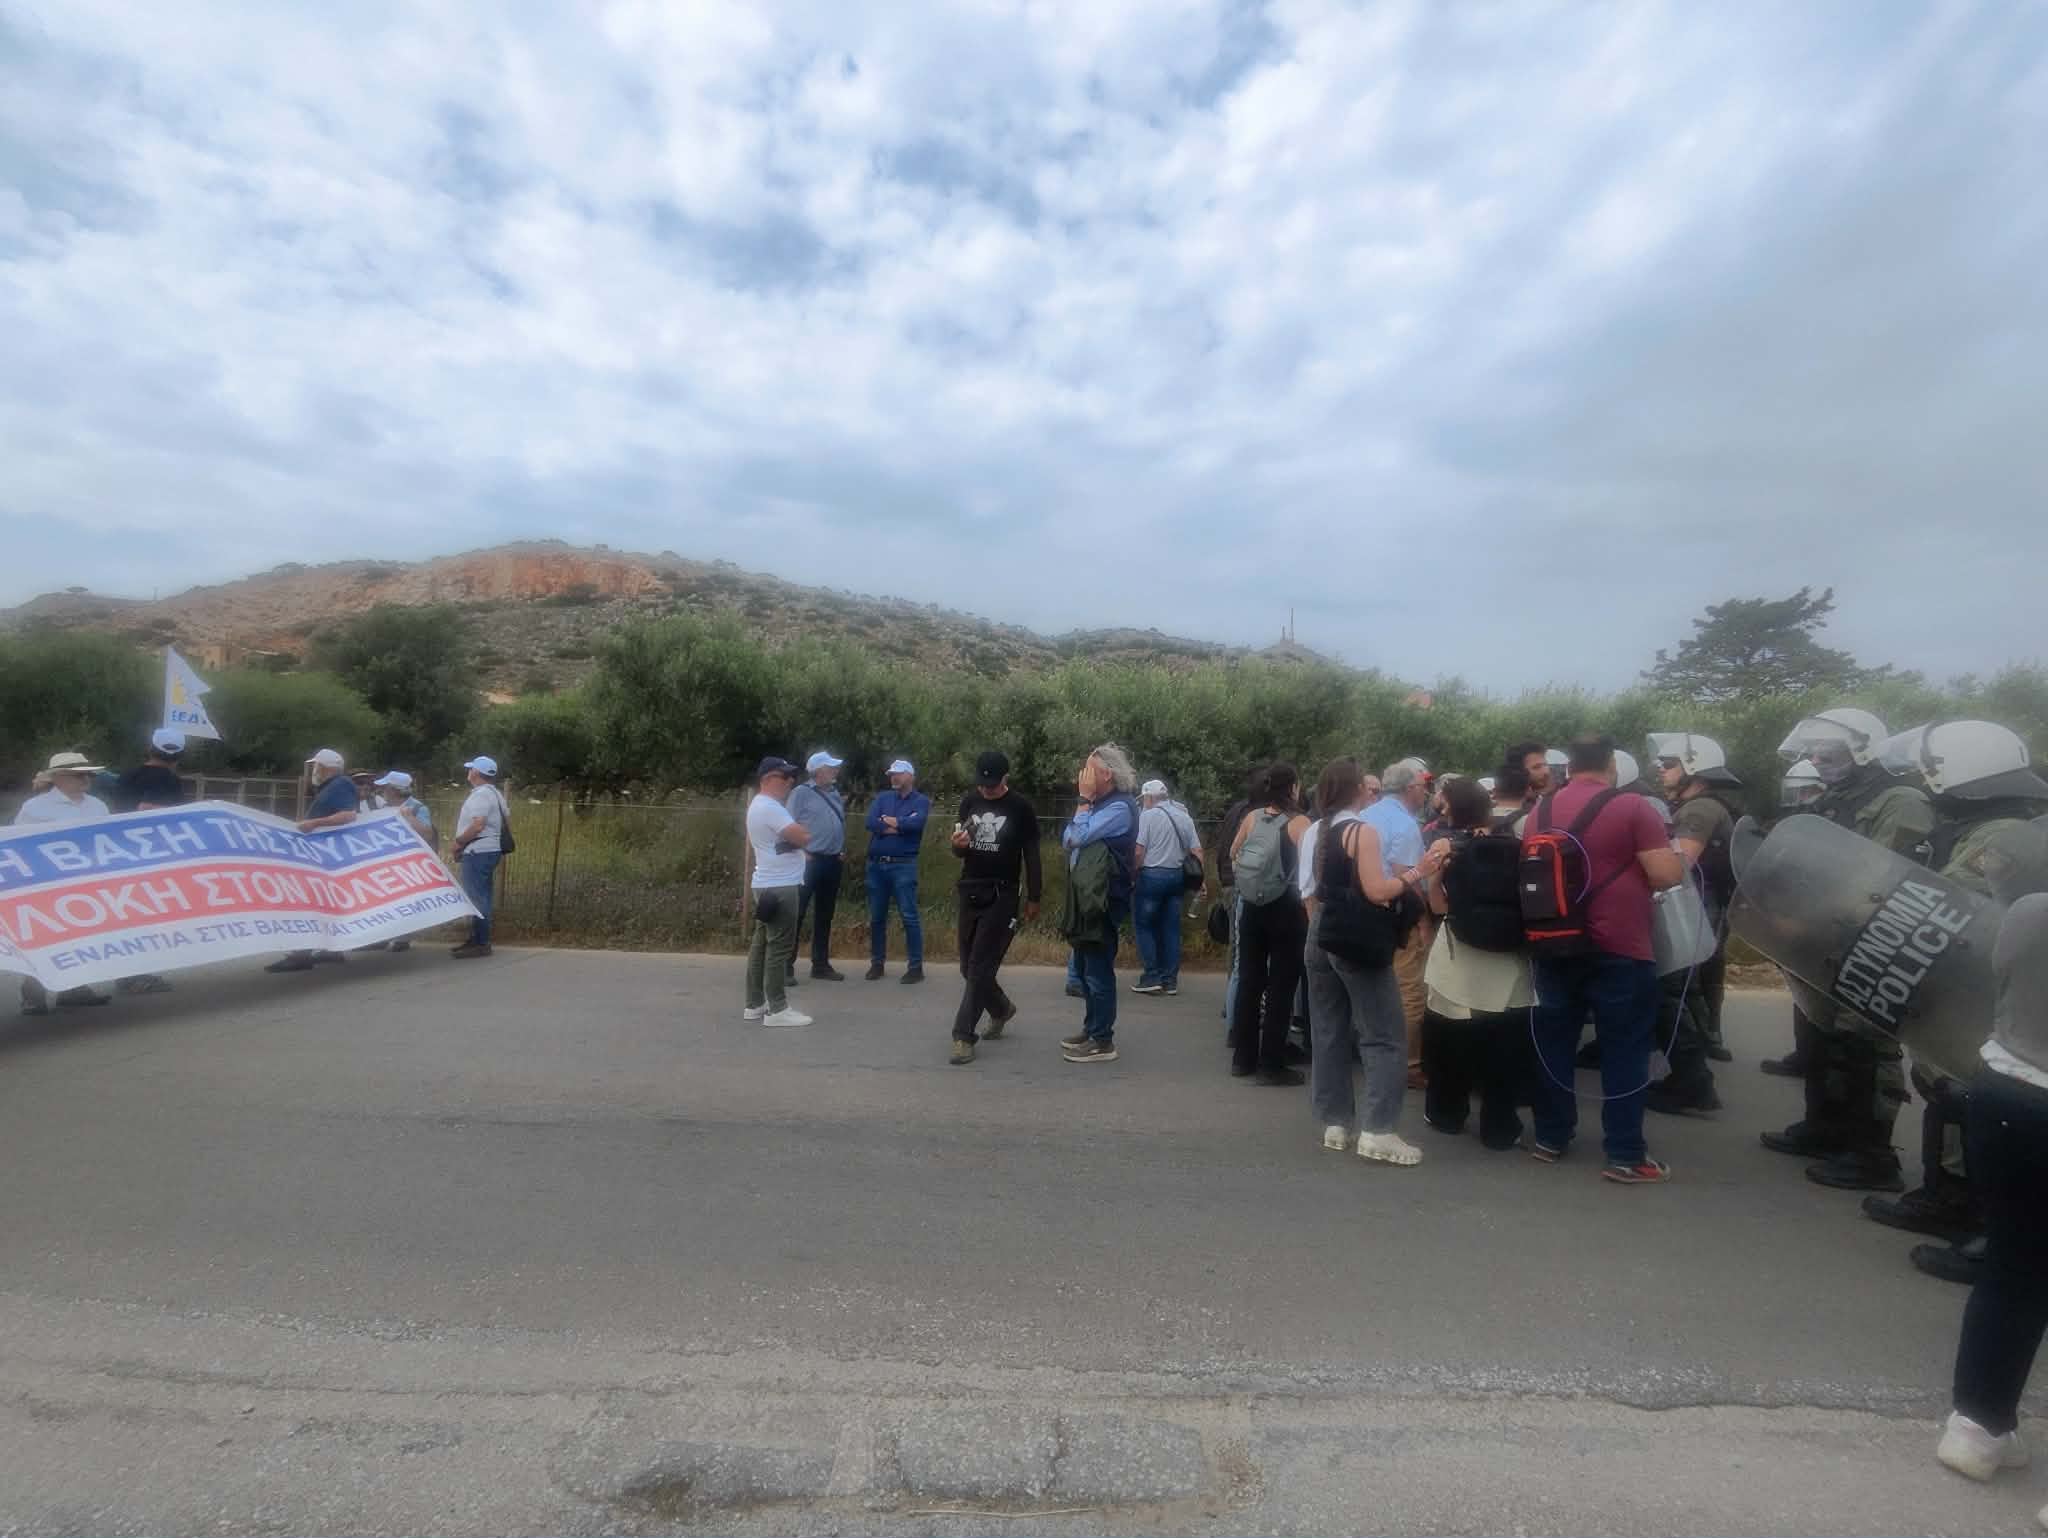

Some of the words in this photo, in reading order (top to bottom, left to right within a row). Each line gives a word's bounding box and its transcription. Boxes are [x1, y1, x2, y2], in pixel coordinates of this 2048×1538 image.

[37, 821, 208, 871] ΒΑΣΗ
[205, 818, 289, 855] ΤΗΣ
[0, 877, 192, 942] ΛΟΚΗ
[191, 871, 311, 907] ΣΤΟΝ
[50, 931, 193, 970] ΕΝΑΝΤΙΑ
[195, 920, 252, 943] ΣΤΙΣ
[1835, 880, 1947, 1010] ΑΣΤΥΝΟΜΙΑ
[1868, 902, 1972, 1024] POLICE
